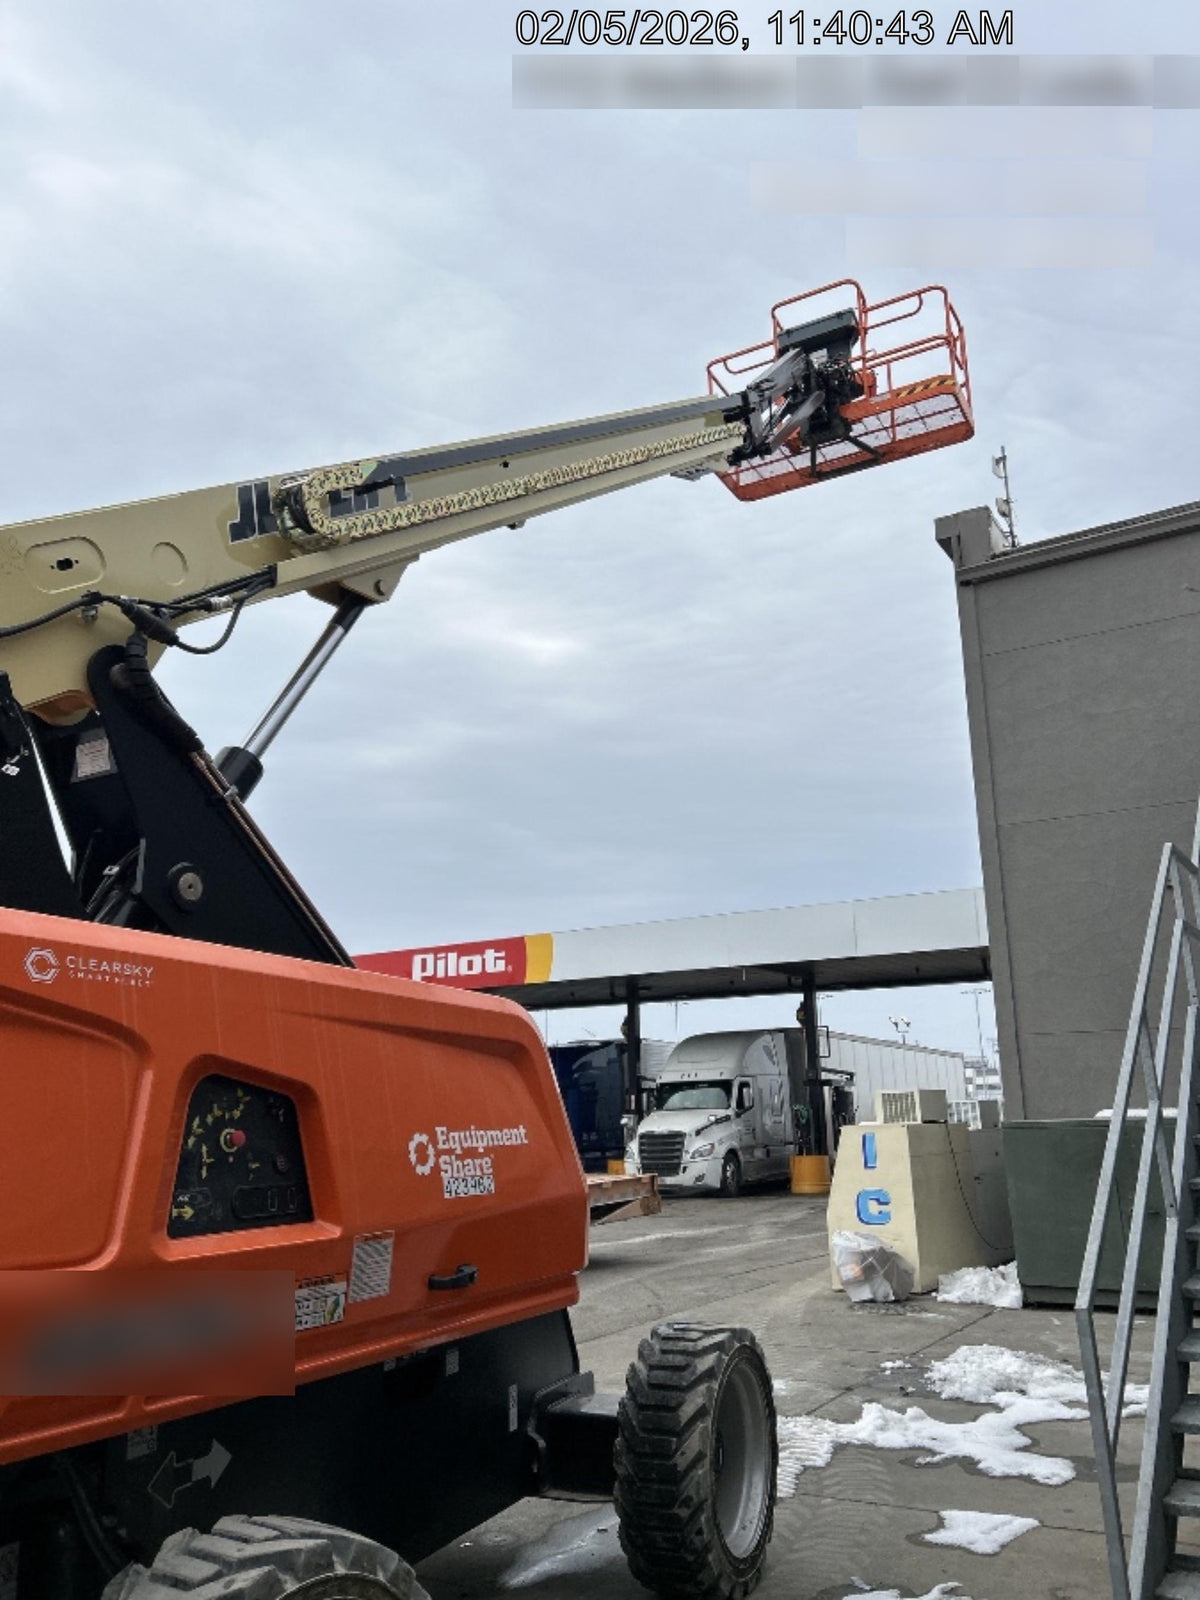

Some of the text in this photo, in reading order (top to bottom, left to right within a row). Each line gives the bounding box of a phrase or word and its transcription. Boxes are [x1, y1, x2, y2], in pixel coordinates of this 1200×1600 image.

[66, 956, 153, 978] CLEARSKY
[435, 1125, 528, 1153] Equipment
[439, 1155, 493, 1177] Share
